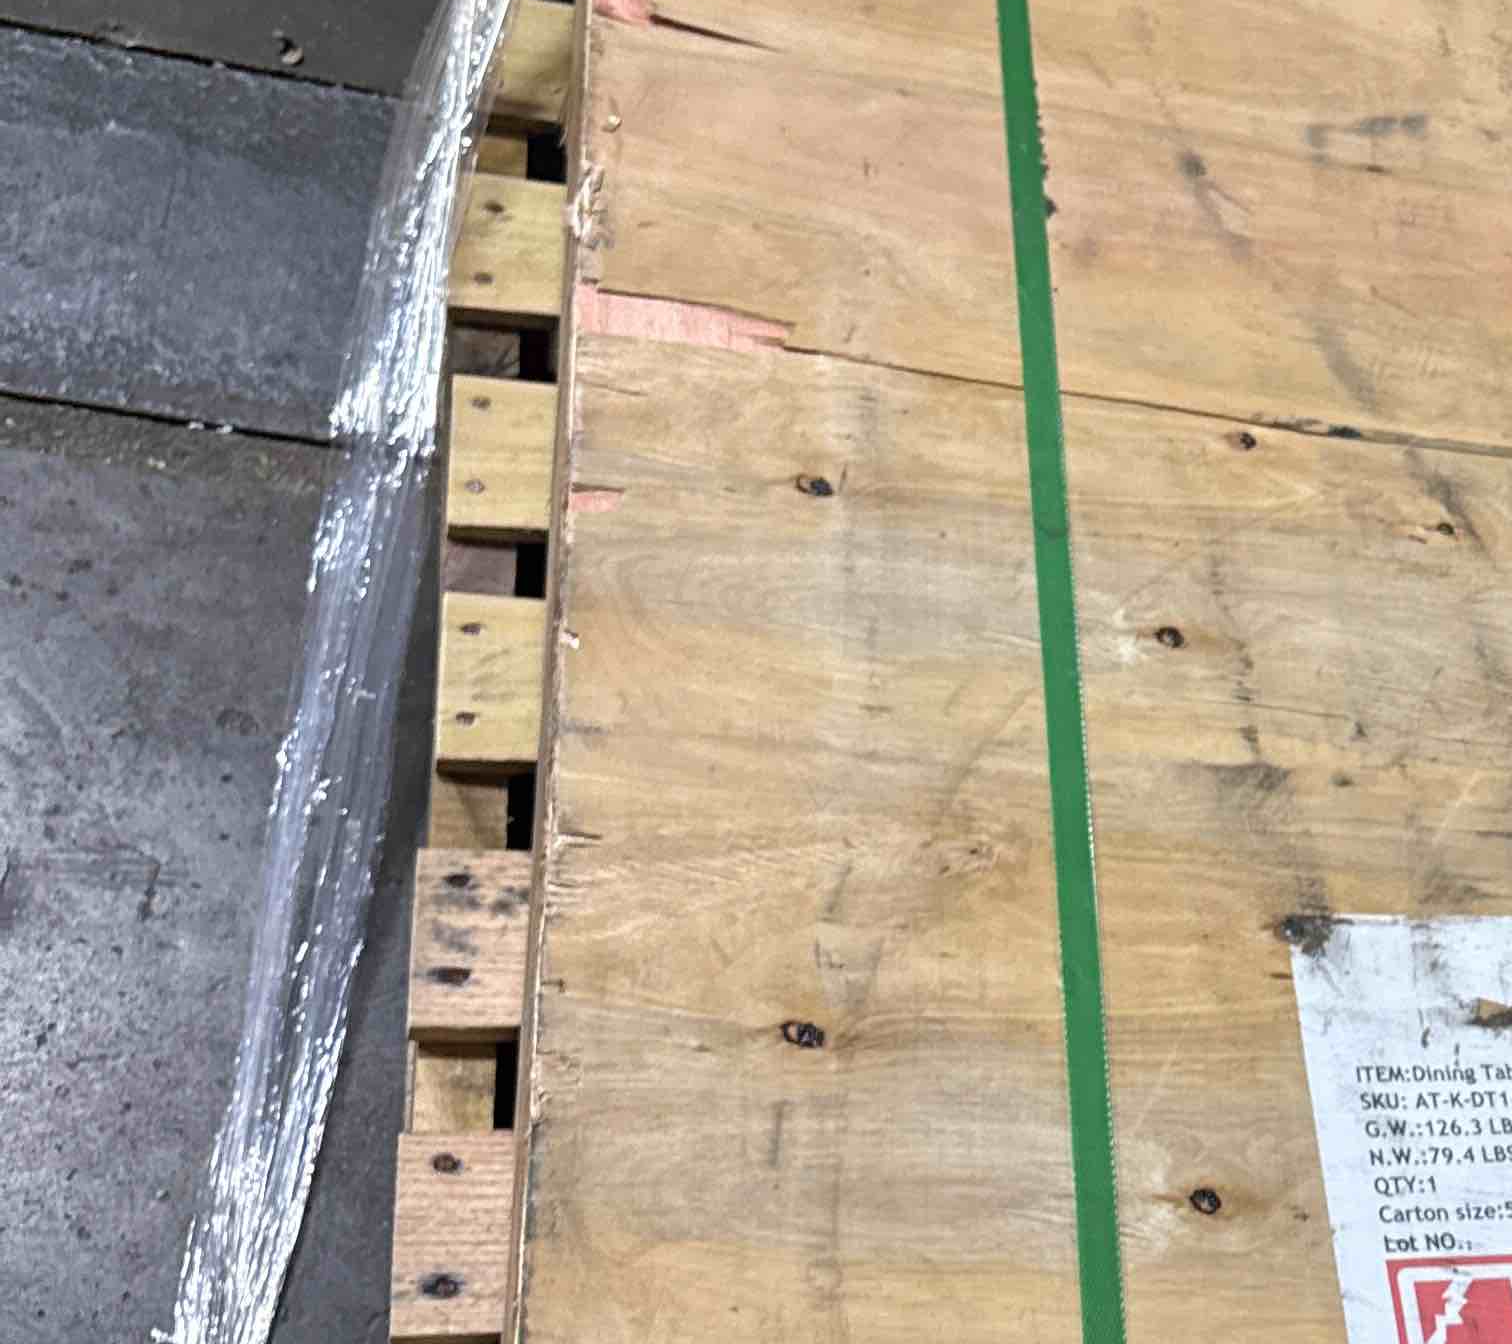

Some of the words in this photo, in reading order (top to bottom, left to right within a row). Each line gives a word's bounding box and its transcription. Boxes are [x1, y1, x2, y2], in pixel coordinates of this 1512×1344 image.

[1355, 1064, 1477, 1084] ITEM:Dining
[1360, 1093, 1408, 1110] SKU:
[1364, 1120, 1483, 1138] G.W.:126.3
[1370, 1147, 1476, 1166] N.W.:79.4
[1374, 1176, 1438, 1196] QTY:1
[1378, 1204, 1449, 1224] Carton
